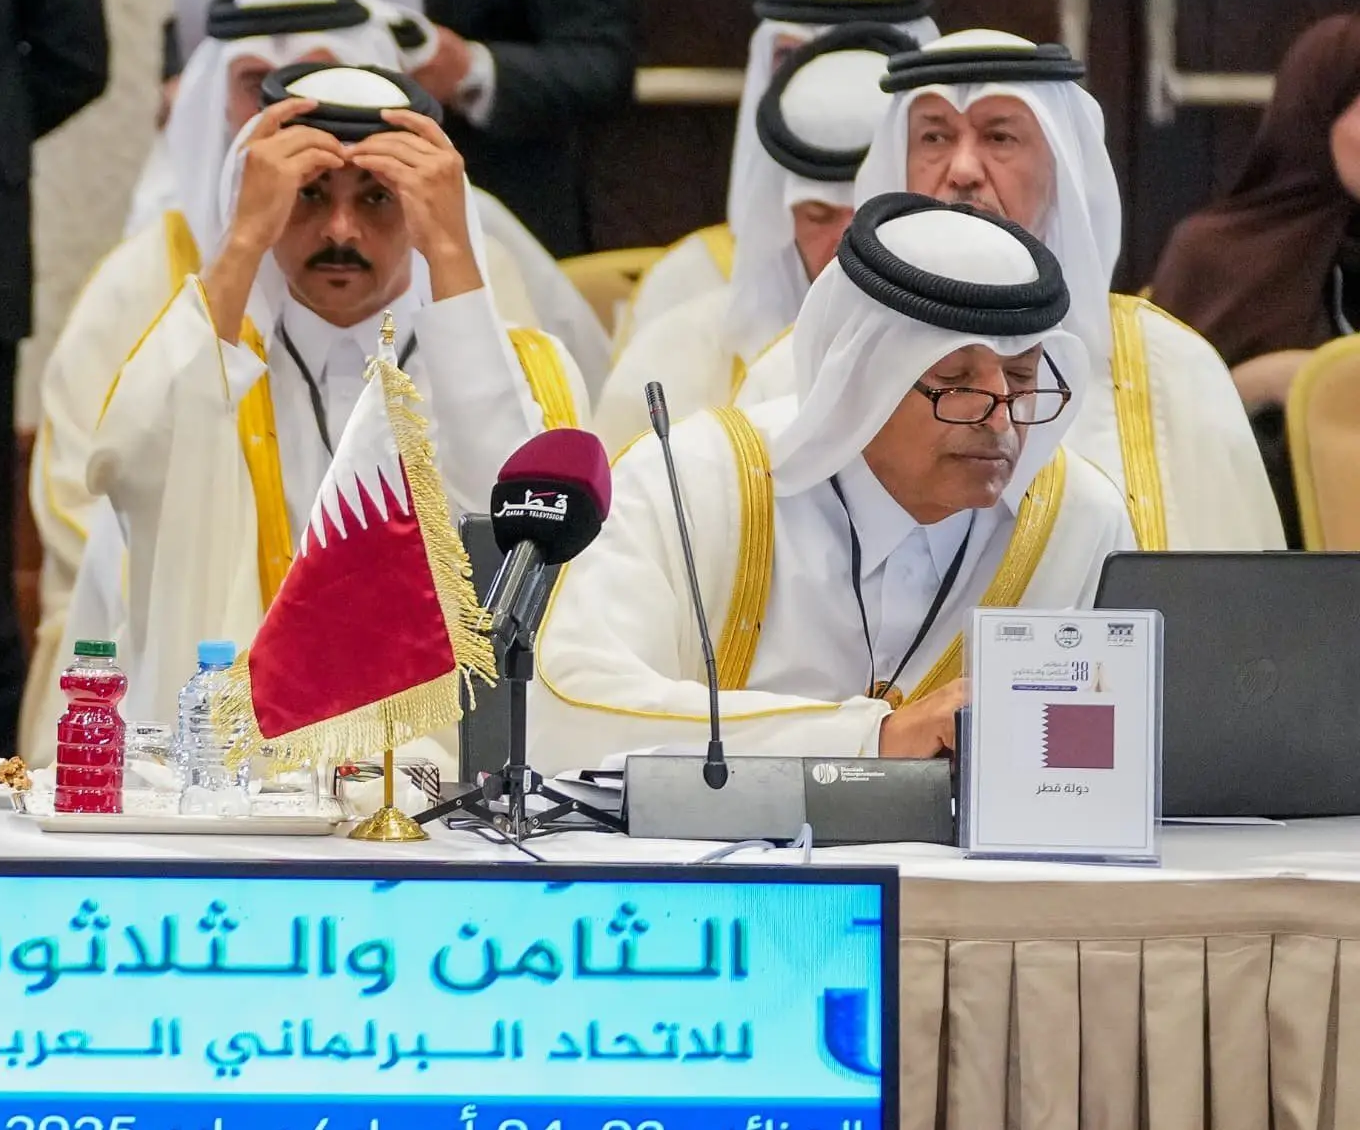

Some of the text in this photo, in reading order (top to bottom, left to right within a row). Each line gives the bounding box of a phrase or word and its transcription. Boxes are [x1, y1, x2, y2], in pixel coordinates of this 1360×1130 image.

[494, 489, 569, 518] قطر
[1035, 781, 1089, 796] دولة قطر
[429, 901, 749, 993] الثامن
[206, 1018, 524, 1078] البرلماني
[548, 1020, 754, 1062] للاتحاد
